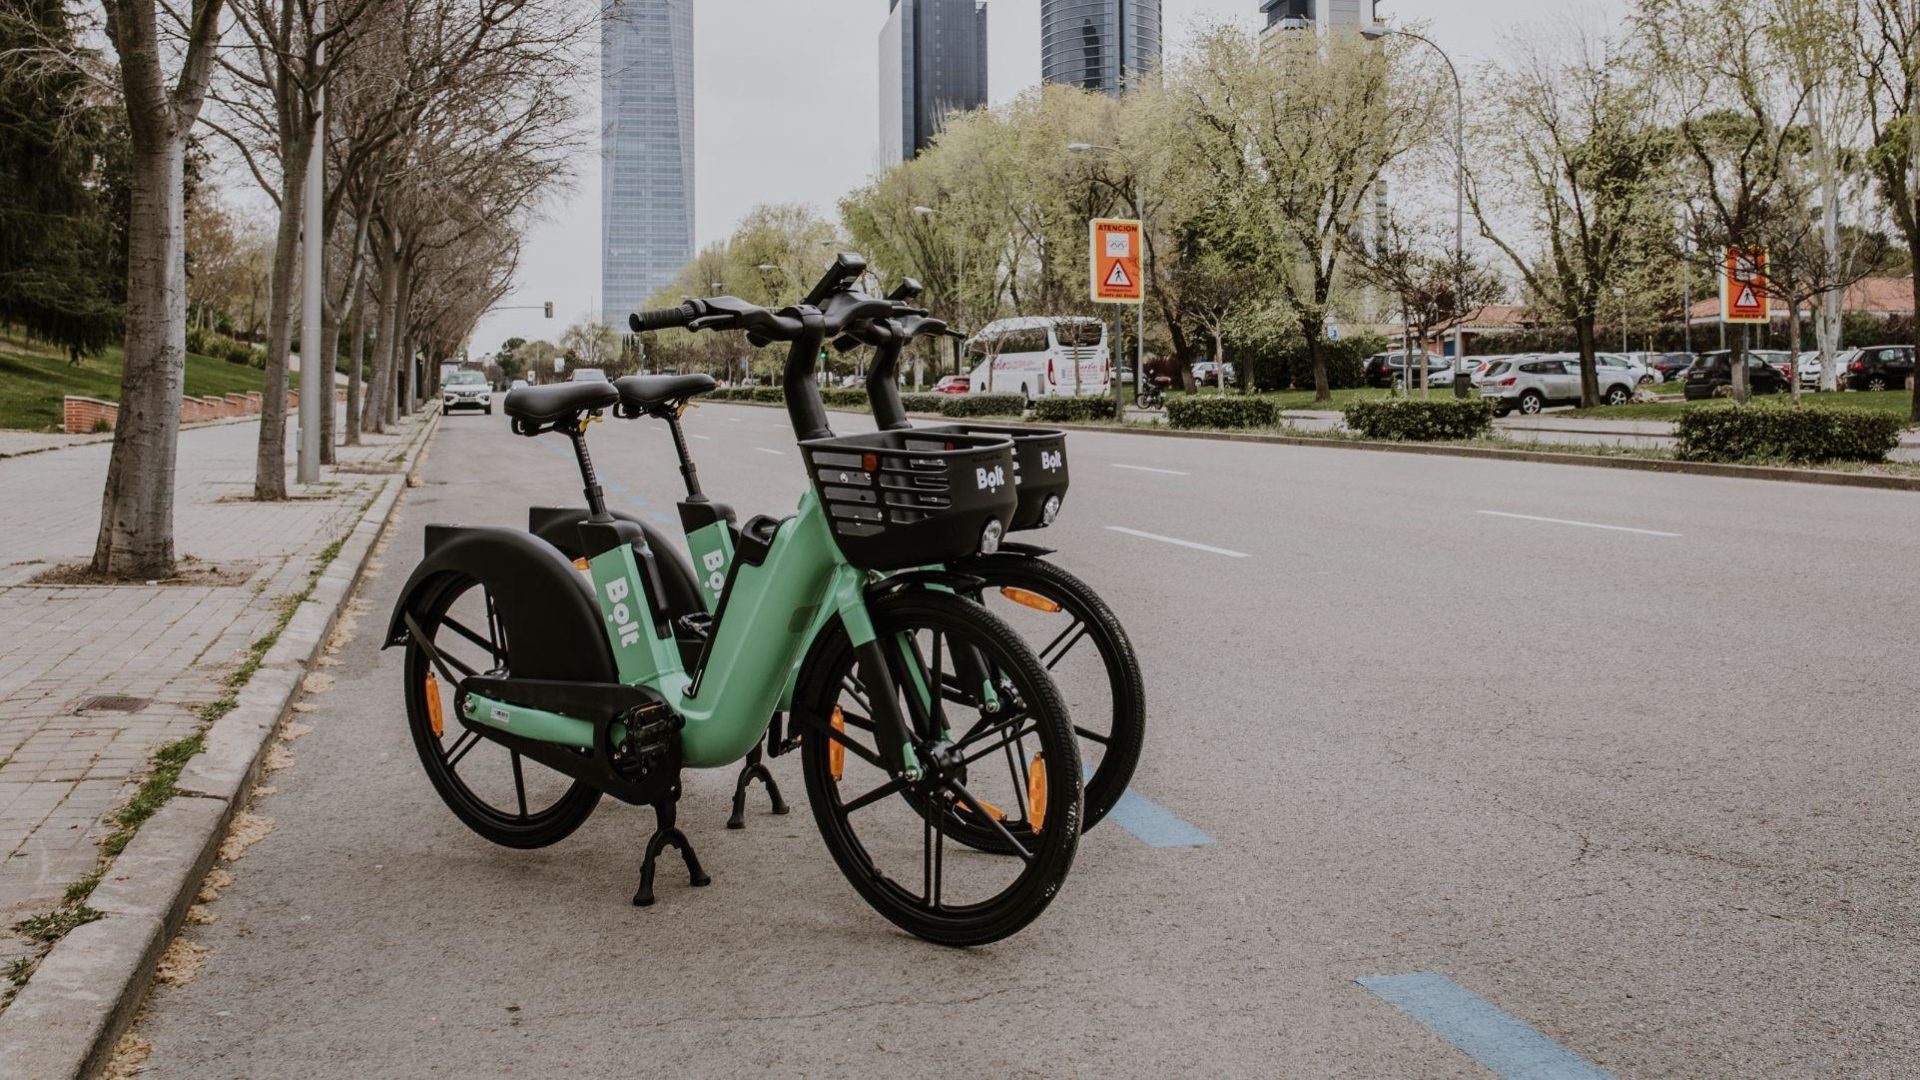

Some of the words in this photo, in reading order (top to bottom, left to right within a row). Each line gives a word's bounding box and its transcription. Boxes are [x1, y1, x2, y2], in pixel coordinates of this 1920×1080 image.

[976, 465, 1005, 494] Bolt
[1041, 450, 1062, 473] Bolt
[702, 549, 725, 599] Bo
[605, 576, 640, 648] Bolt
